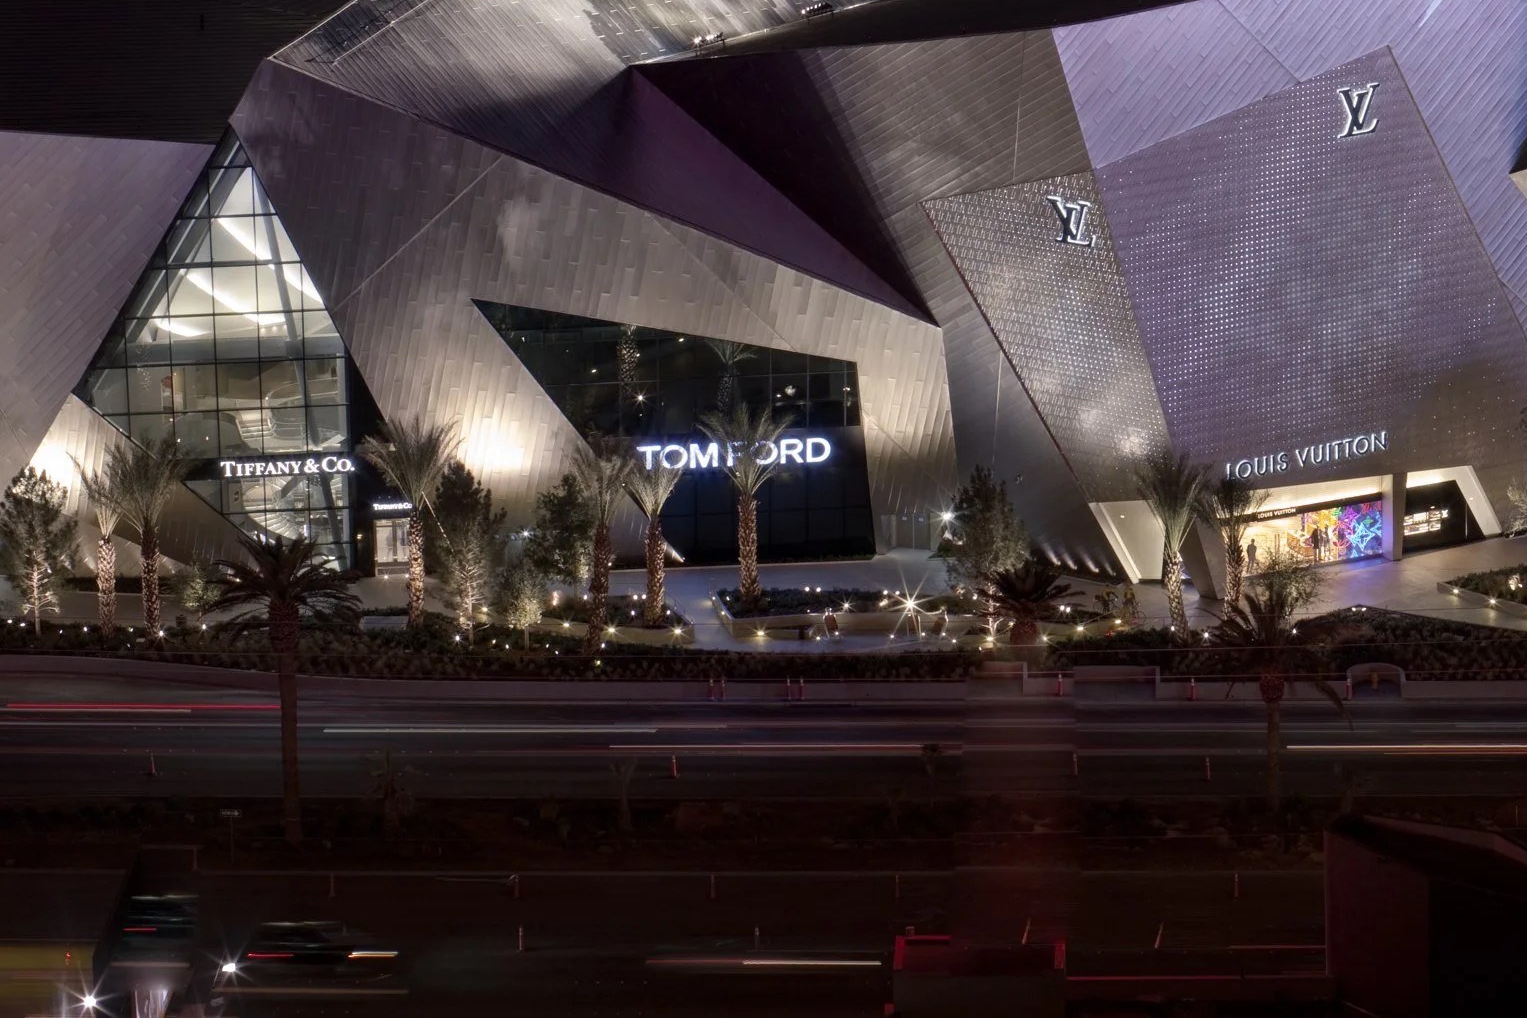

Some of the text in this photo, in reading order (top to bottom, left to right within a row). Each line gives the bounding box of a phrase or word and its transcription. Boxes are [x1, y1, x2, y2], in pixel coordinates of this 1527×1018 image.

[636, 437, 832, 471] TOM FORD
[1226, 431, 1389, 481] LOUIS VUITTON
[220, 460, 301, 478] TIFFANY
[304, 458, 319, 474] &
[1257, 507, 1296, 519] LOUIS VUITTON
